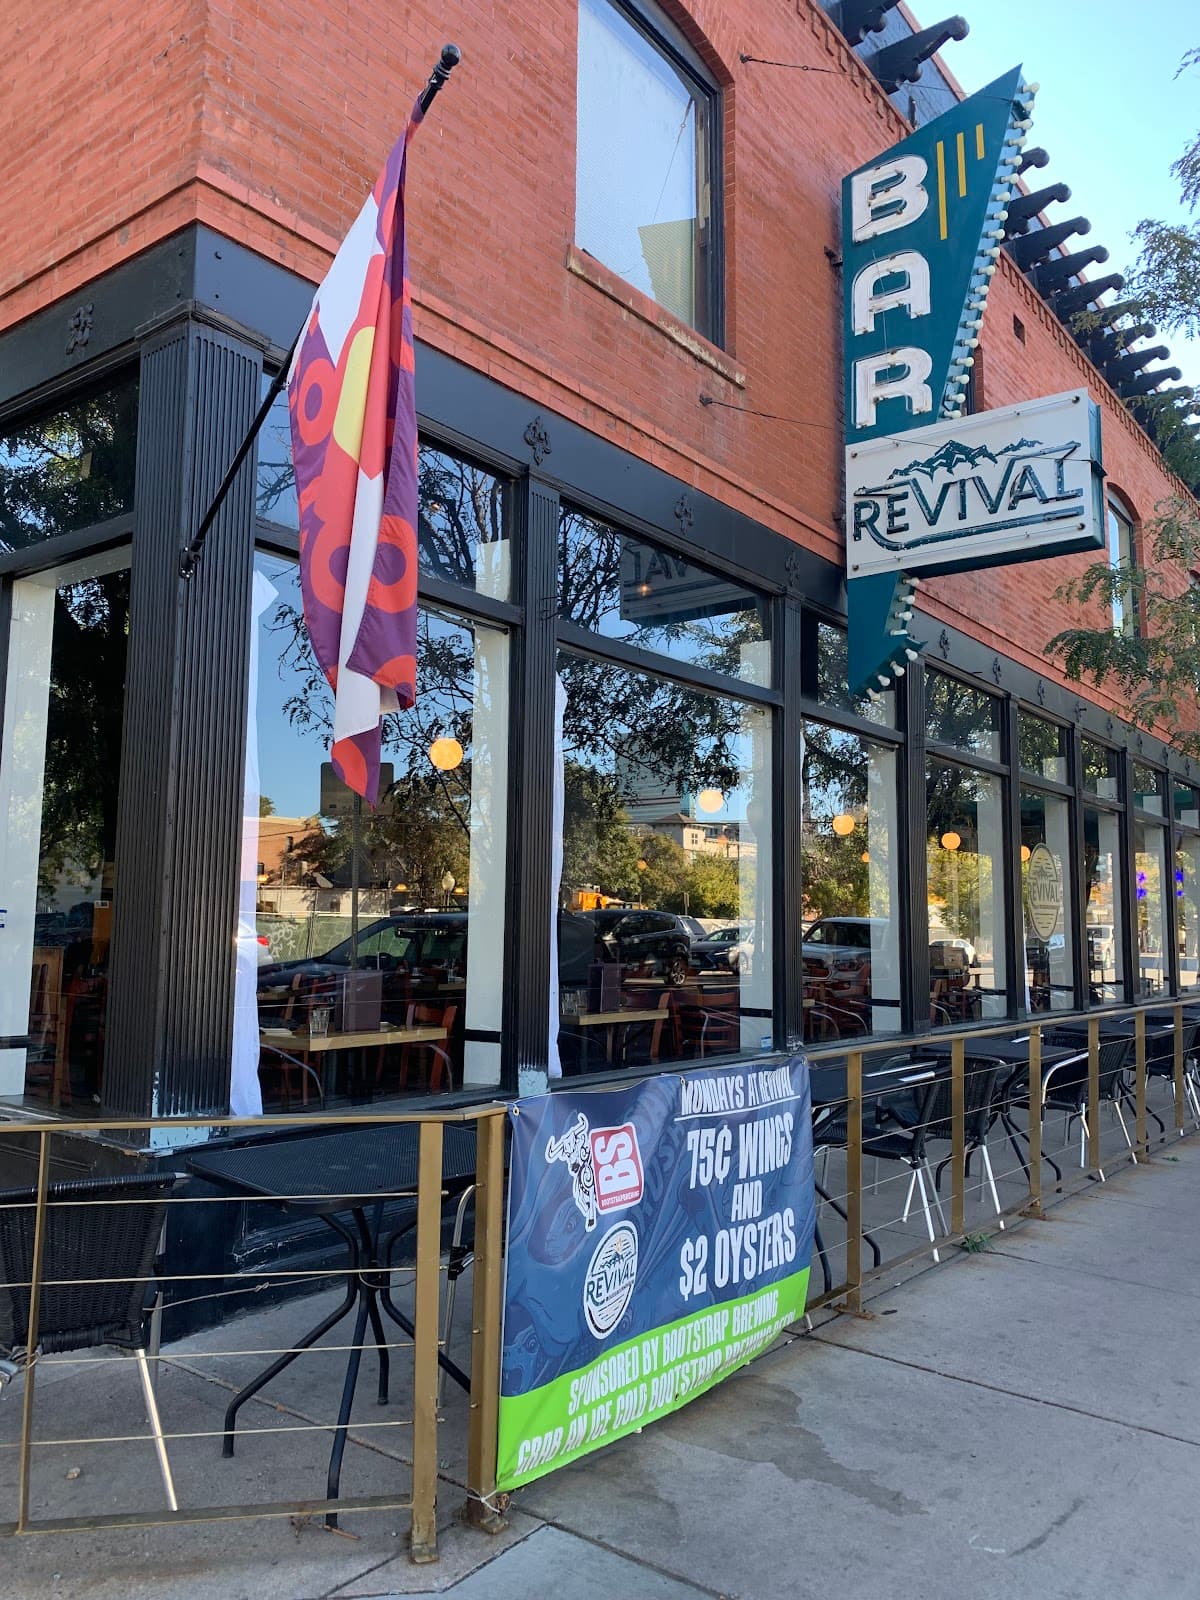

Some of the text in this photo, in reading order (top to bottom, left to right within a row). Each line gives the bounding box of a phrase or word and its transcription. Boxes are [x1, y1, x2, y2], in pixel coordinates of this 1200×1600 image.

[851, 153, 933, 430] BAR
[853, 441, 1085, 551] REVIVAL
[1028, 880, 1060, 903] REVIVAL
[681, 1065, 795, 1116] MONDAYS AT REVIVAL
[594, 1132, 639, 1195] BS
[687, 1112, 794, 1190] 75¢ WINGS
[731, 1179, 763, 1222] AND
[586, 1259, 635, 1307] REVIVAL
[679, 1207, 796, 1302] $2 OYSTERS
[568, 1289, 779, 1416] SPONSORED BY BOOTSTRAP BREWING
[513, 1426, 564, 1477] GRAB
[560, 1413, 588, 1455] AN
[586, 1400, 613, 1443] ICE
[613, 1382, 647, 1430] COLD
[649, 1349, 722, 1412] BOOTSTRAP
